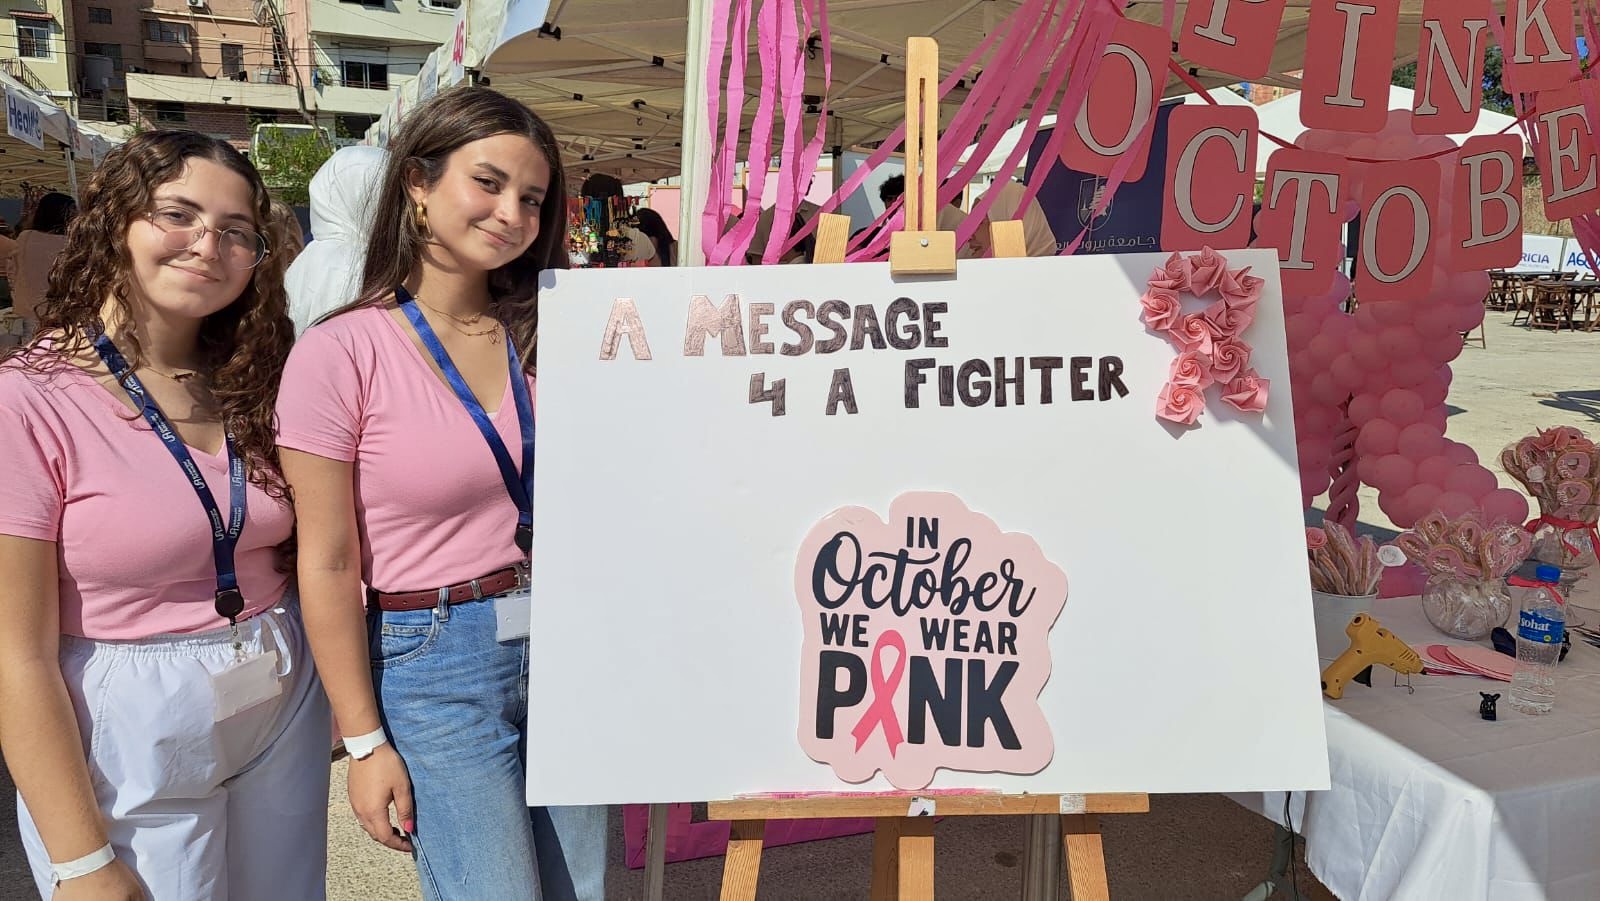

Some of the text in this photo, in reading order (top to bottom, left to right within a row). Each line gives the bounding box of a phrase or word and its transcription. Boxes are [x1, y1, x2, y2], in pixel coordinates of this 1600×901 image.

[1108, 235, 1156, 249] جامعة
[599, 293, 949, 361] A MESSAGE
[748, 355, 1130, 417] 4 A FIGHTER
[906, 516, 939, 550] IN
[812, 531, 1037, 617] October
[819, 612, 1018, 655] WE WEAR
